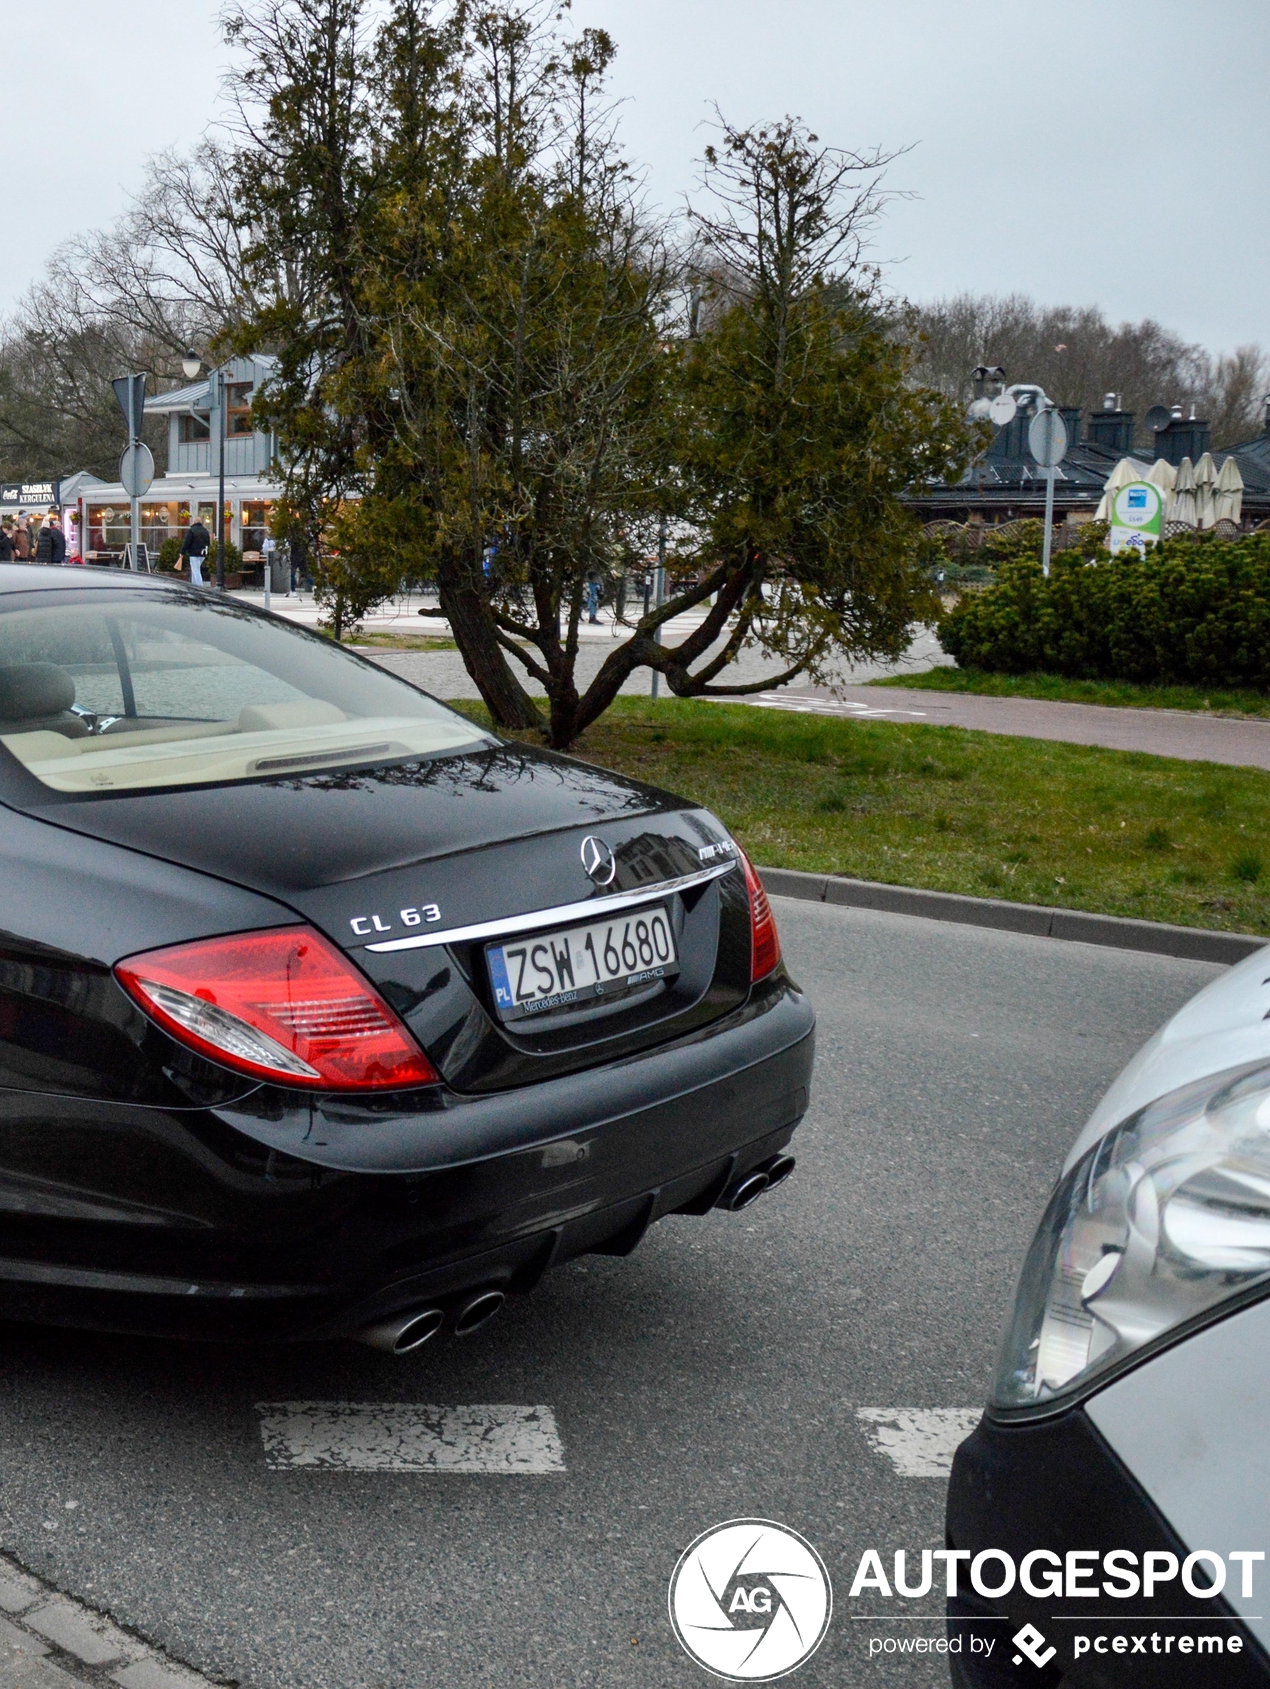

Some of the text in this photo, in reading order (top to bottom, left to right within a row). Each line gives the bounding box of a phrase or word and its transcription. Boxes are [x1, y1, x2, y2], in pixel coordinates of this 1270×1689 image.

[20, 494, 55, 503] KERGULENA
[350, 903, 442, 936] CL 63
[496, 916, 670, 1003] PL ZSW 16680
[523, 990, 578, 1014] Mercedes-Benz
